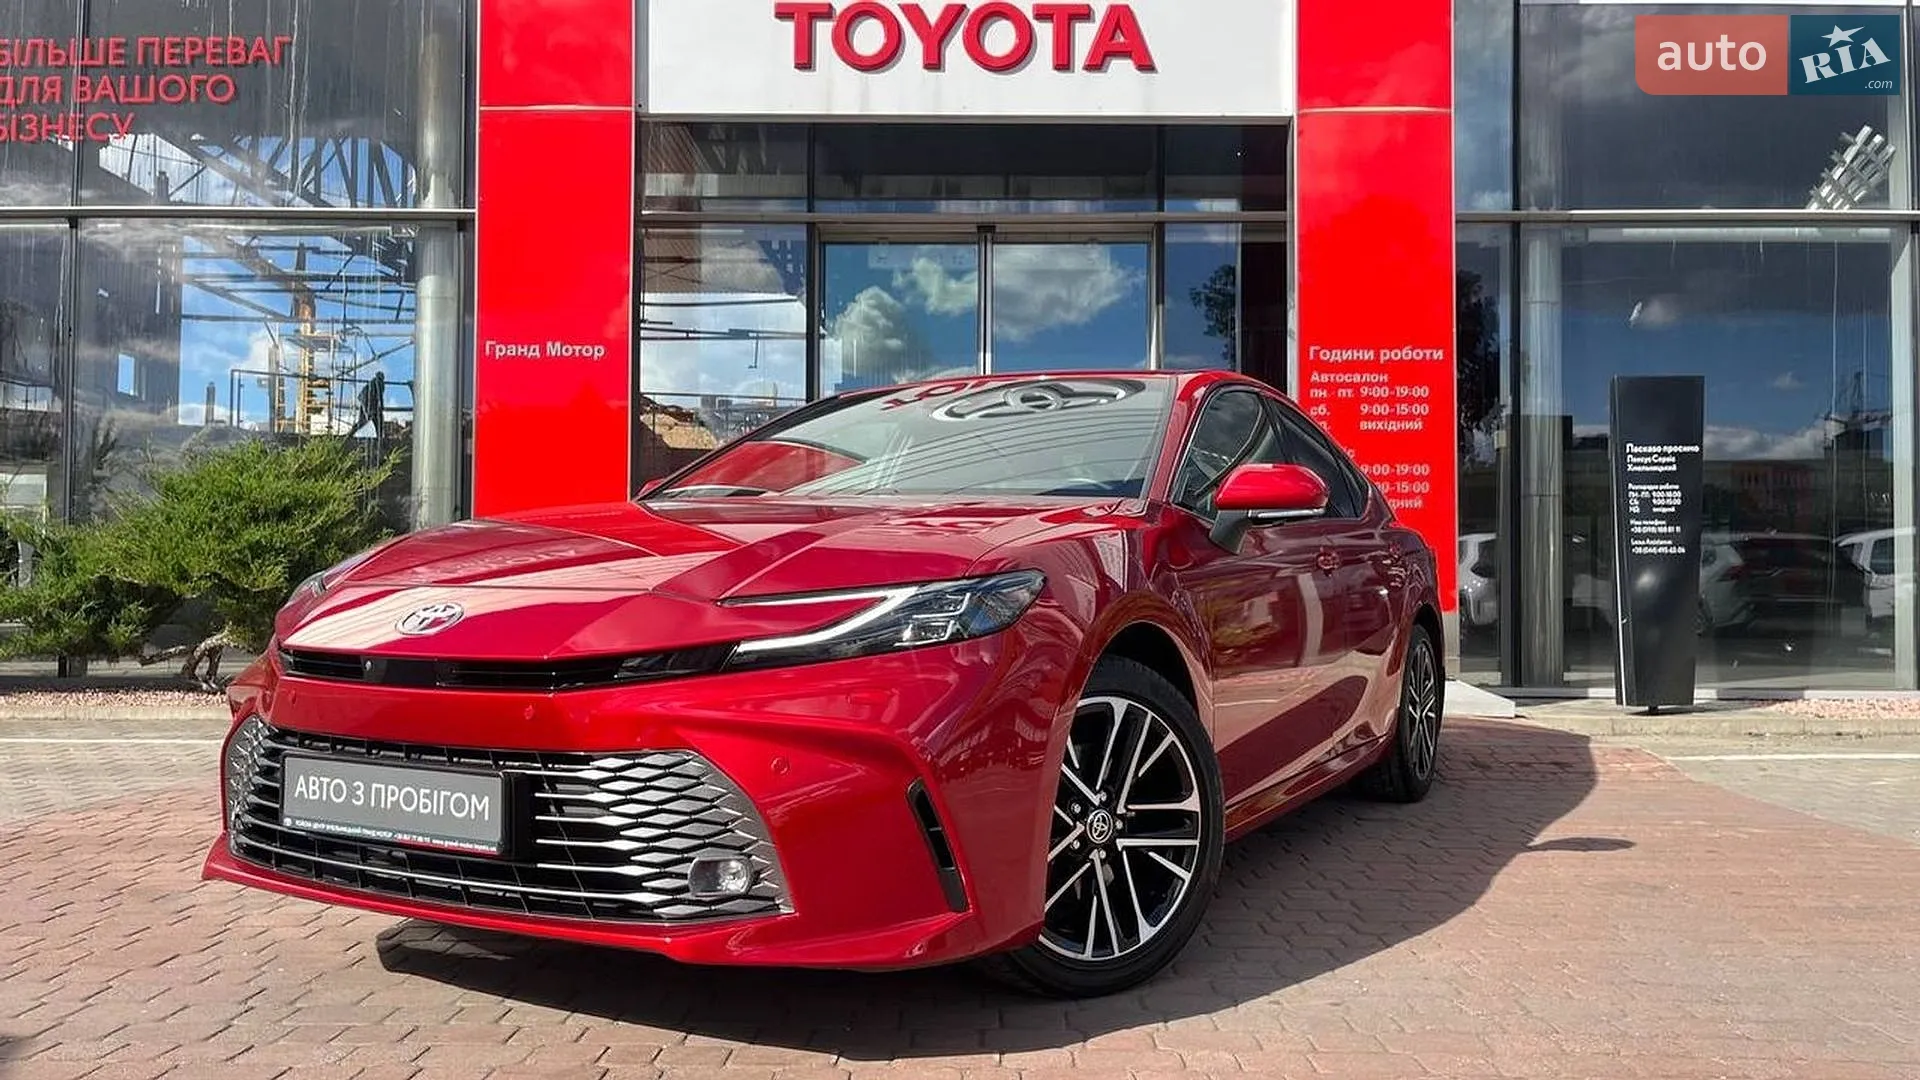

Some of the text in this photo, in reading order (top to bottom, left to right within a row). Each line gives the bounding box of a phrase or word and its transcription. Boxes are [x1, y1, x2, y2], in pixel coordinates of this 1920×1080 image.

[774, 1, 1156, 72] TOYOTA
[136, 35, 292, 66] ПЕРЕВАГ
[0, 73, 236, 108] ДЛЯ ВАШОГО
[485, 340, 605, 361] Гранд Мотор
[1309, 345, 1444, 364] Години роботи
[1310, 370, 1389, 383] Автосалон
[1360, 385, 1430, 398] 9:00-19:00
[1310, 403, 1430, 416] сб. 9:00-15:00
[1360, 418, 1423, 432] вихідний
[294, 775, 490, 821] АВТО З ПРОБІГОМ
